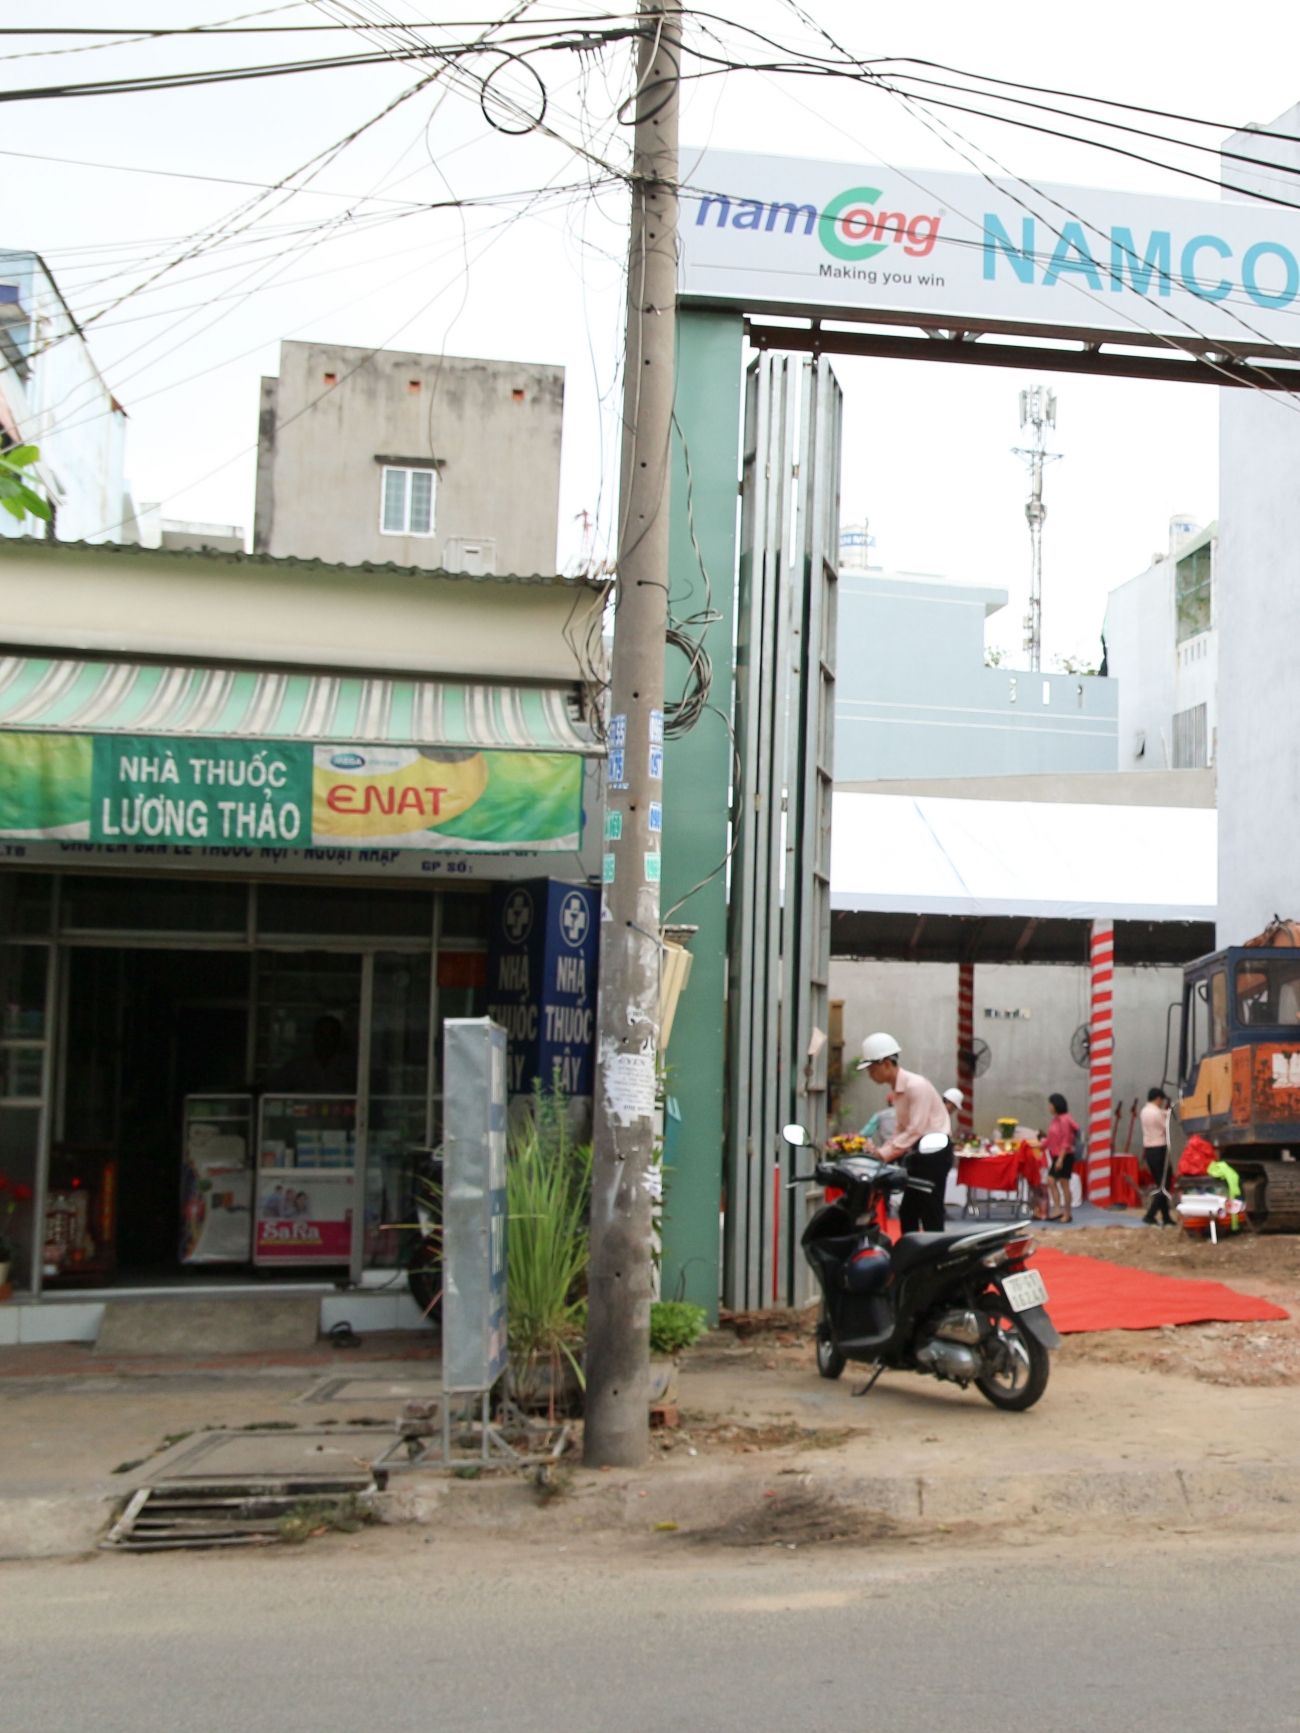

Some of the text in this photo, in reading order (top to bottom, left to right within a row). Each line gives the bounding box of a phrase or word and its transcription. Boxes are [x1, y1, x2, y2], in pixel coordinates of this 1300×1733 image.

[819, 263, 945, 288] Making you win
[119, 750, 288, 788] NHÀ THUỐC
[102, 787, 301, 841] LƯƠNG THẢO
[326, 784, 448, 816] ENAT
[556, 948, 587, 995] NHÀ
[545, 994, 594, 1045] THUỐC
[262, 1221, 320, 1240] SaRa
